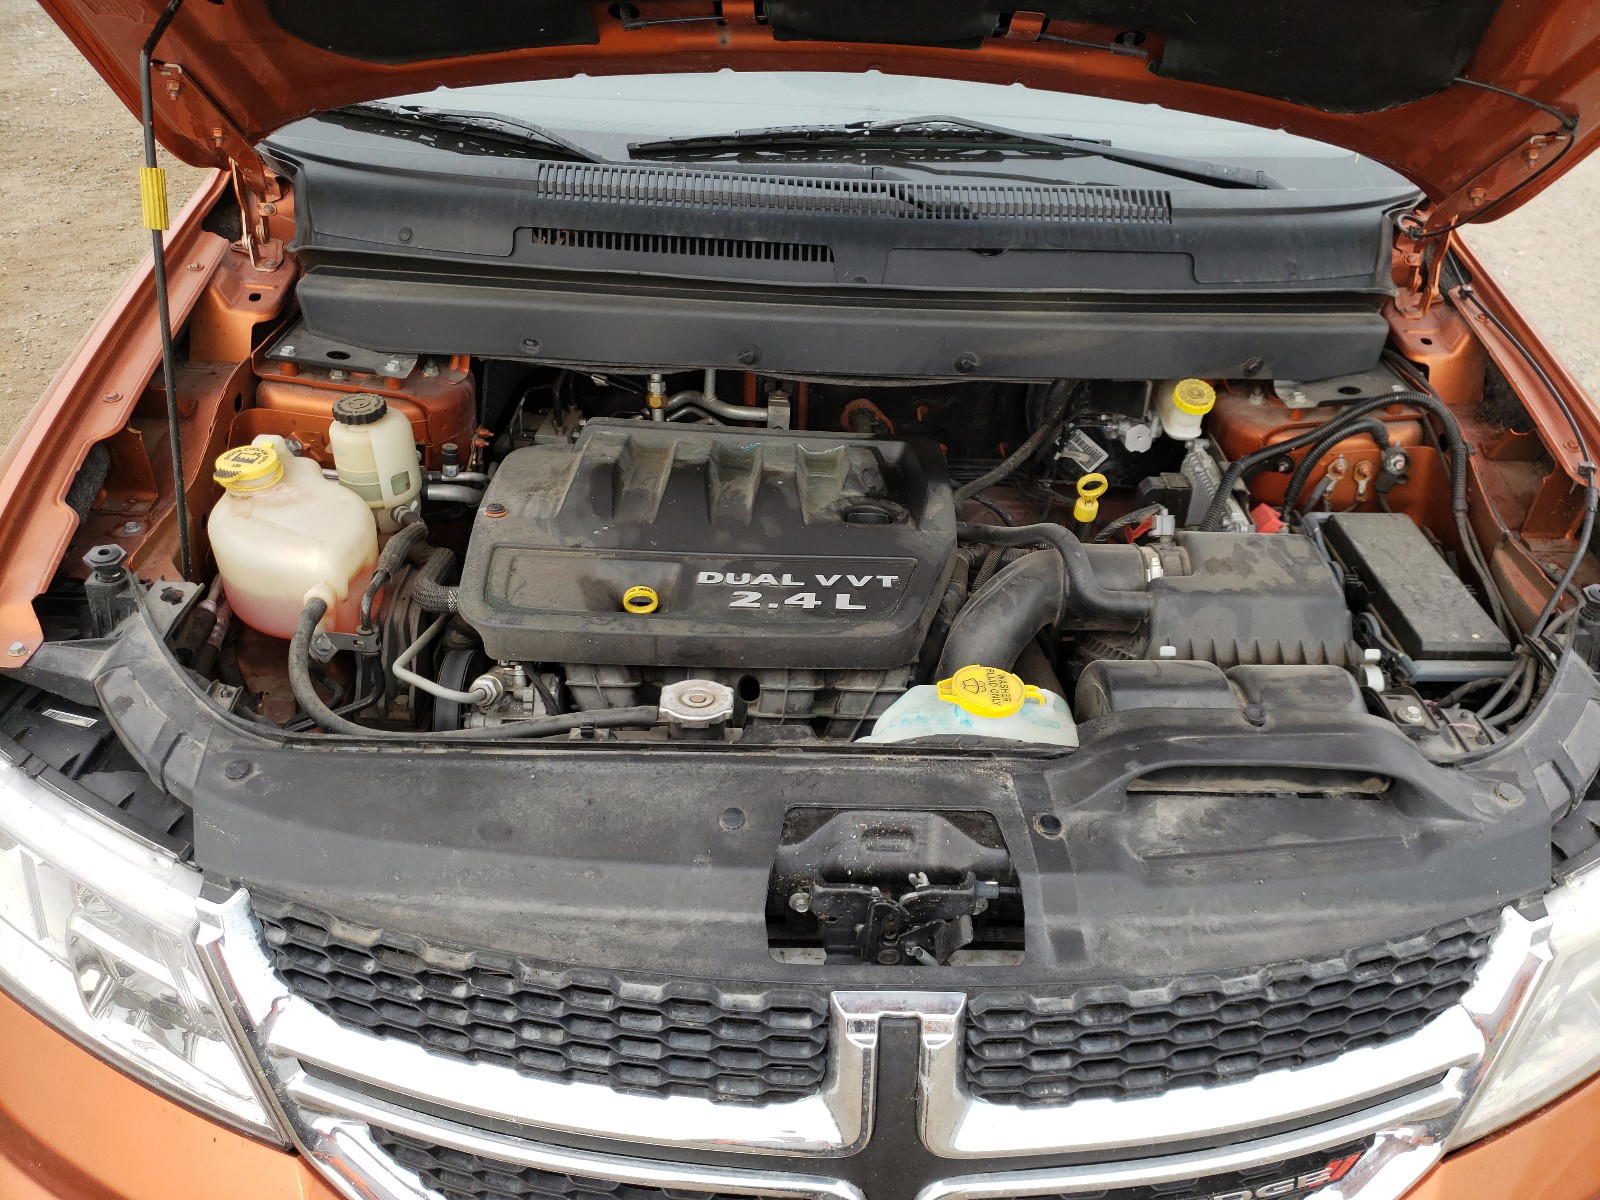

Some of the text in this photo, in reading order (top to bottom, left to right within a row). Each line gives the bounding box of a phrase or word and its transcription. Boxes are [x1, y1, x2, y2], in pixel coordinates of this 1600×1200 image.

[697, 571, 899, 588] DUAL VVT
[986, 669, 1001, 705] FLUID ONLY
[998, 674, 1011, 702] WASHER
